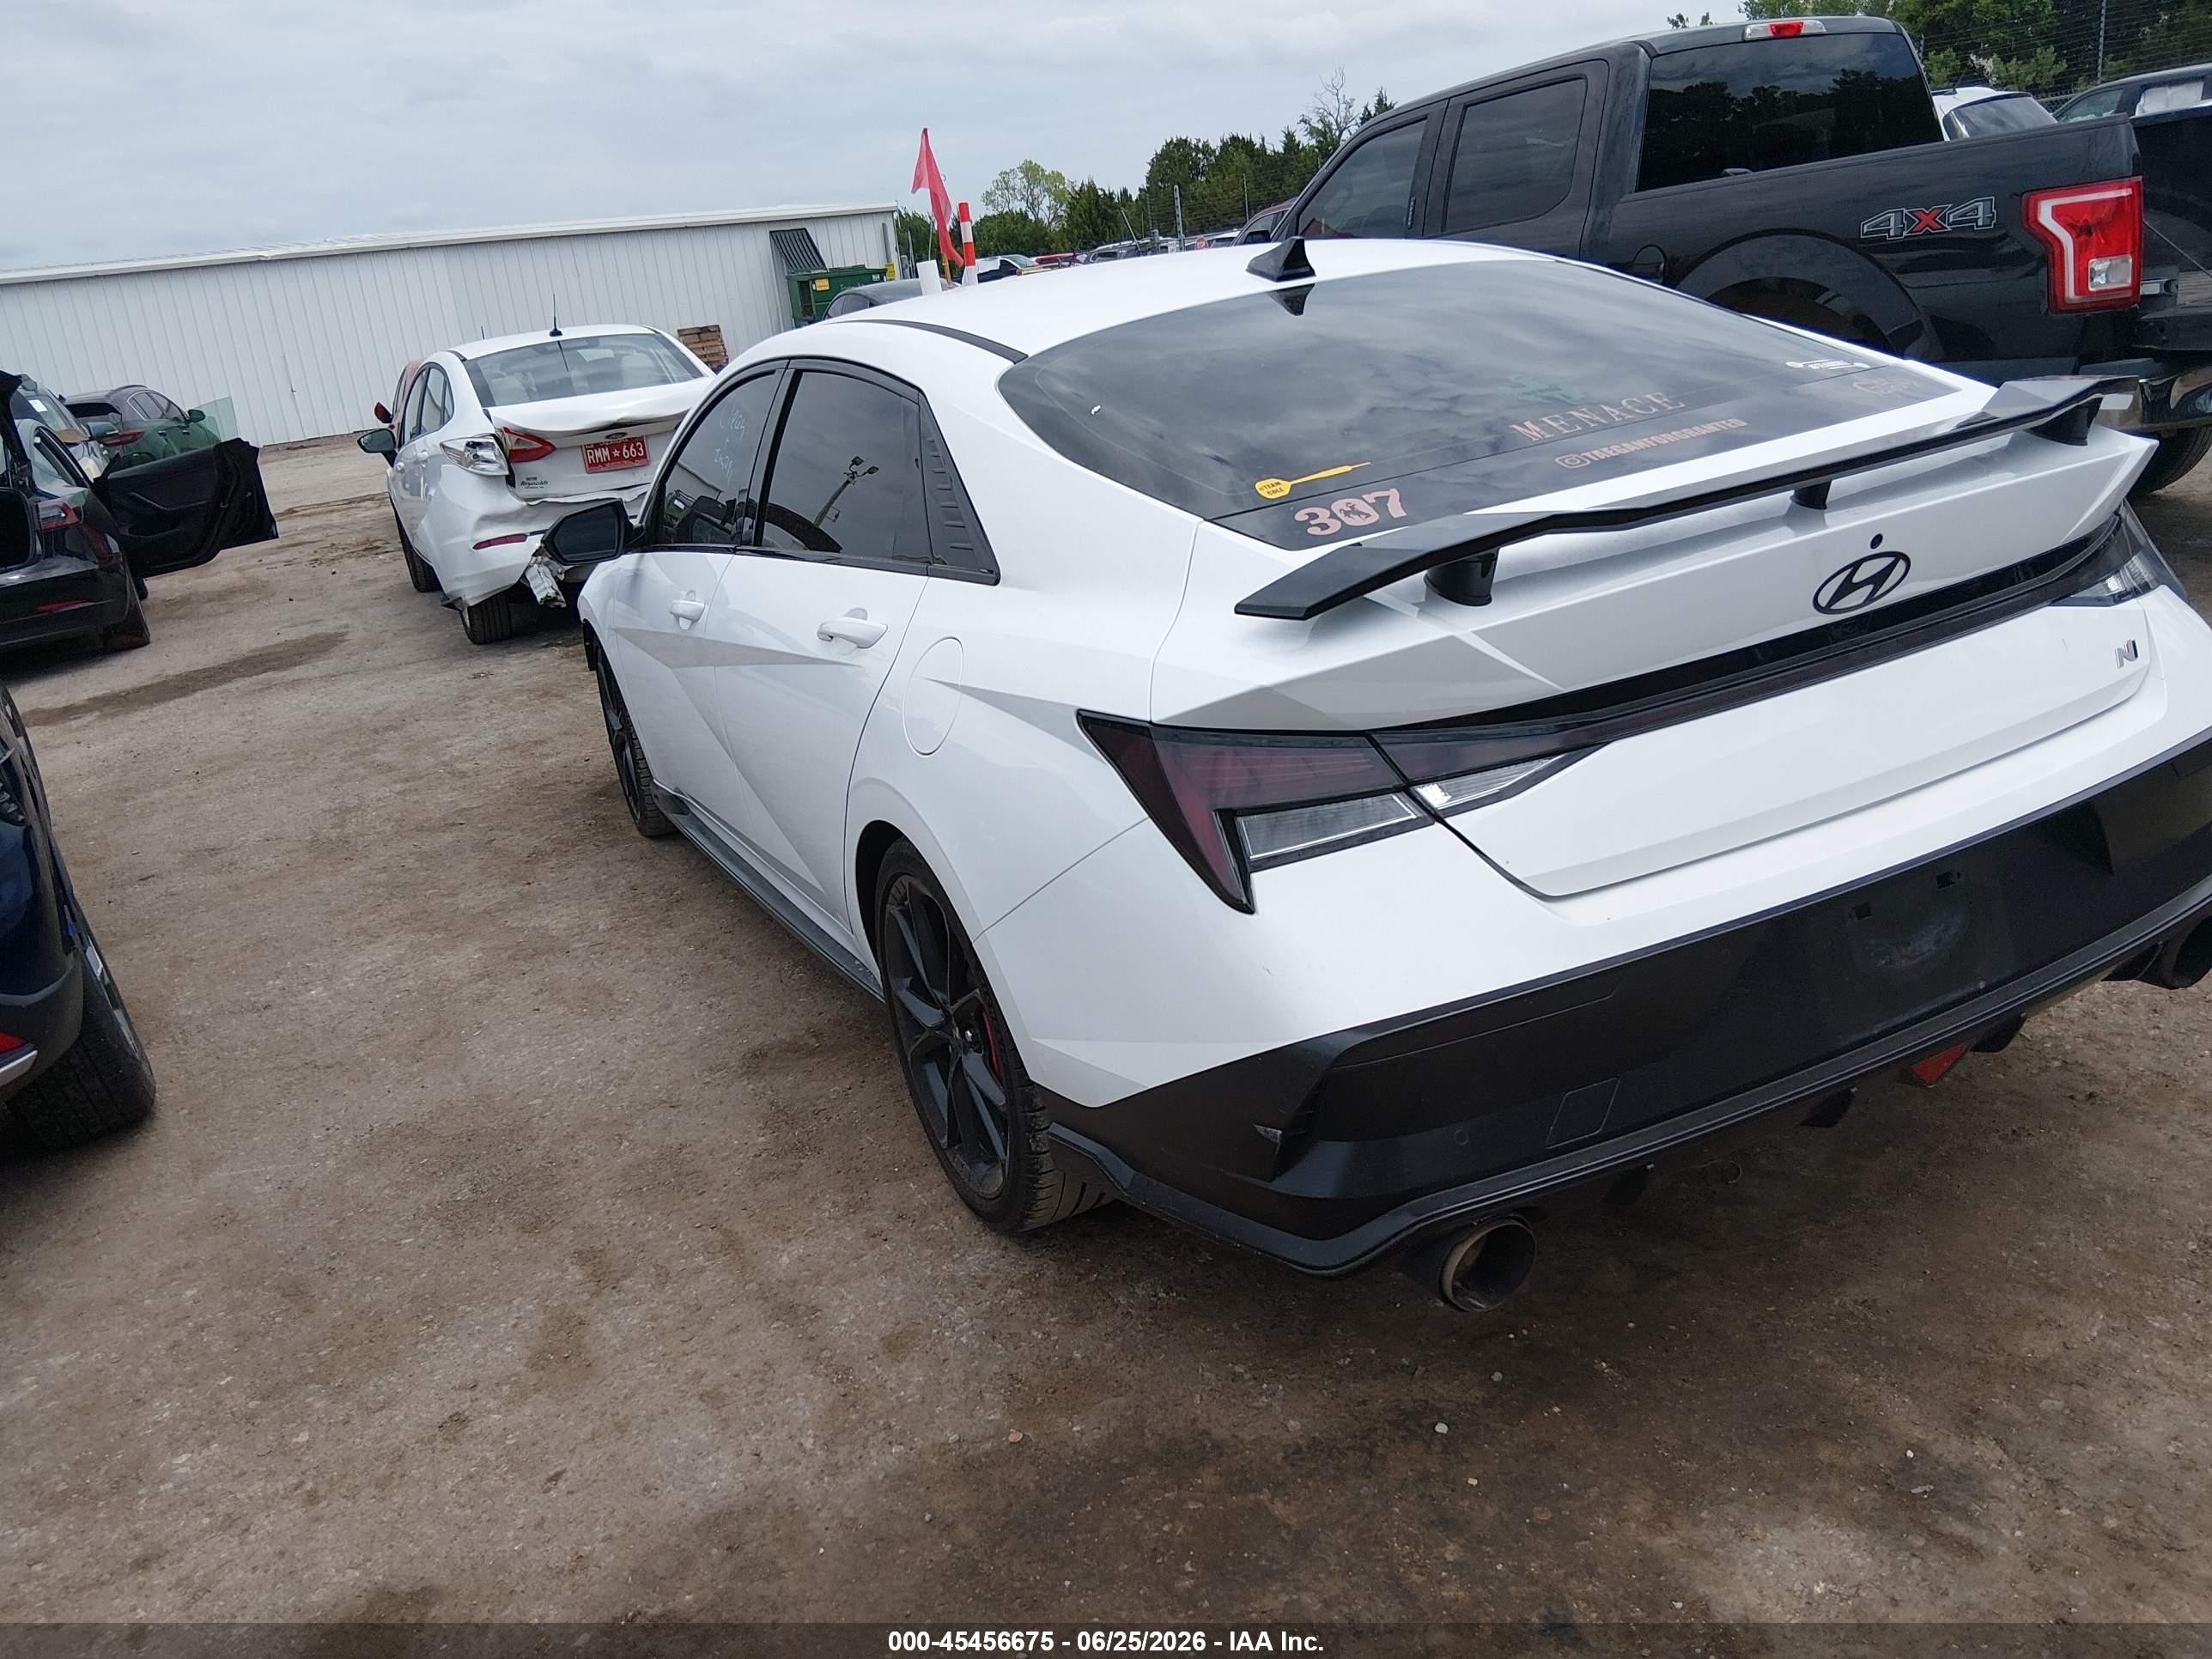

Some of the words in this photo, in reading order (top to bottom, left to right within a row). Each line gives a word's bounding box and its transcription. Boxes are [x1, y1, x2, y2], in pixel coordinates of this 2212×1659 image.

[1861, 197, 1996, 240] 4X4
[1510, 391, 1686, 441] MENACE
[586, 447, 611, 465] RMM
[623, 441, 644, 459] 663
[1294, 487, 1407, 536] 307
